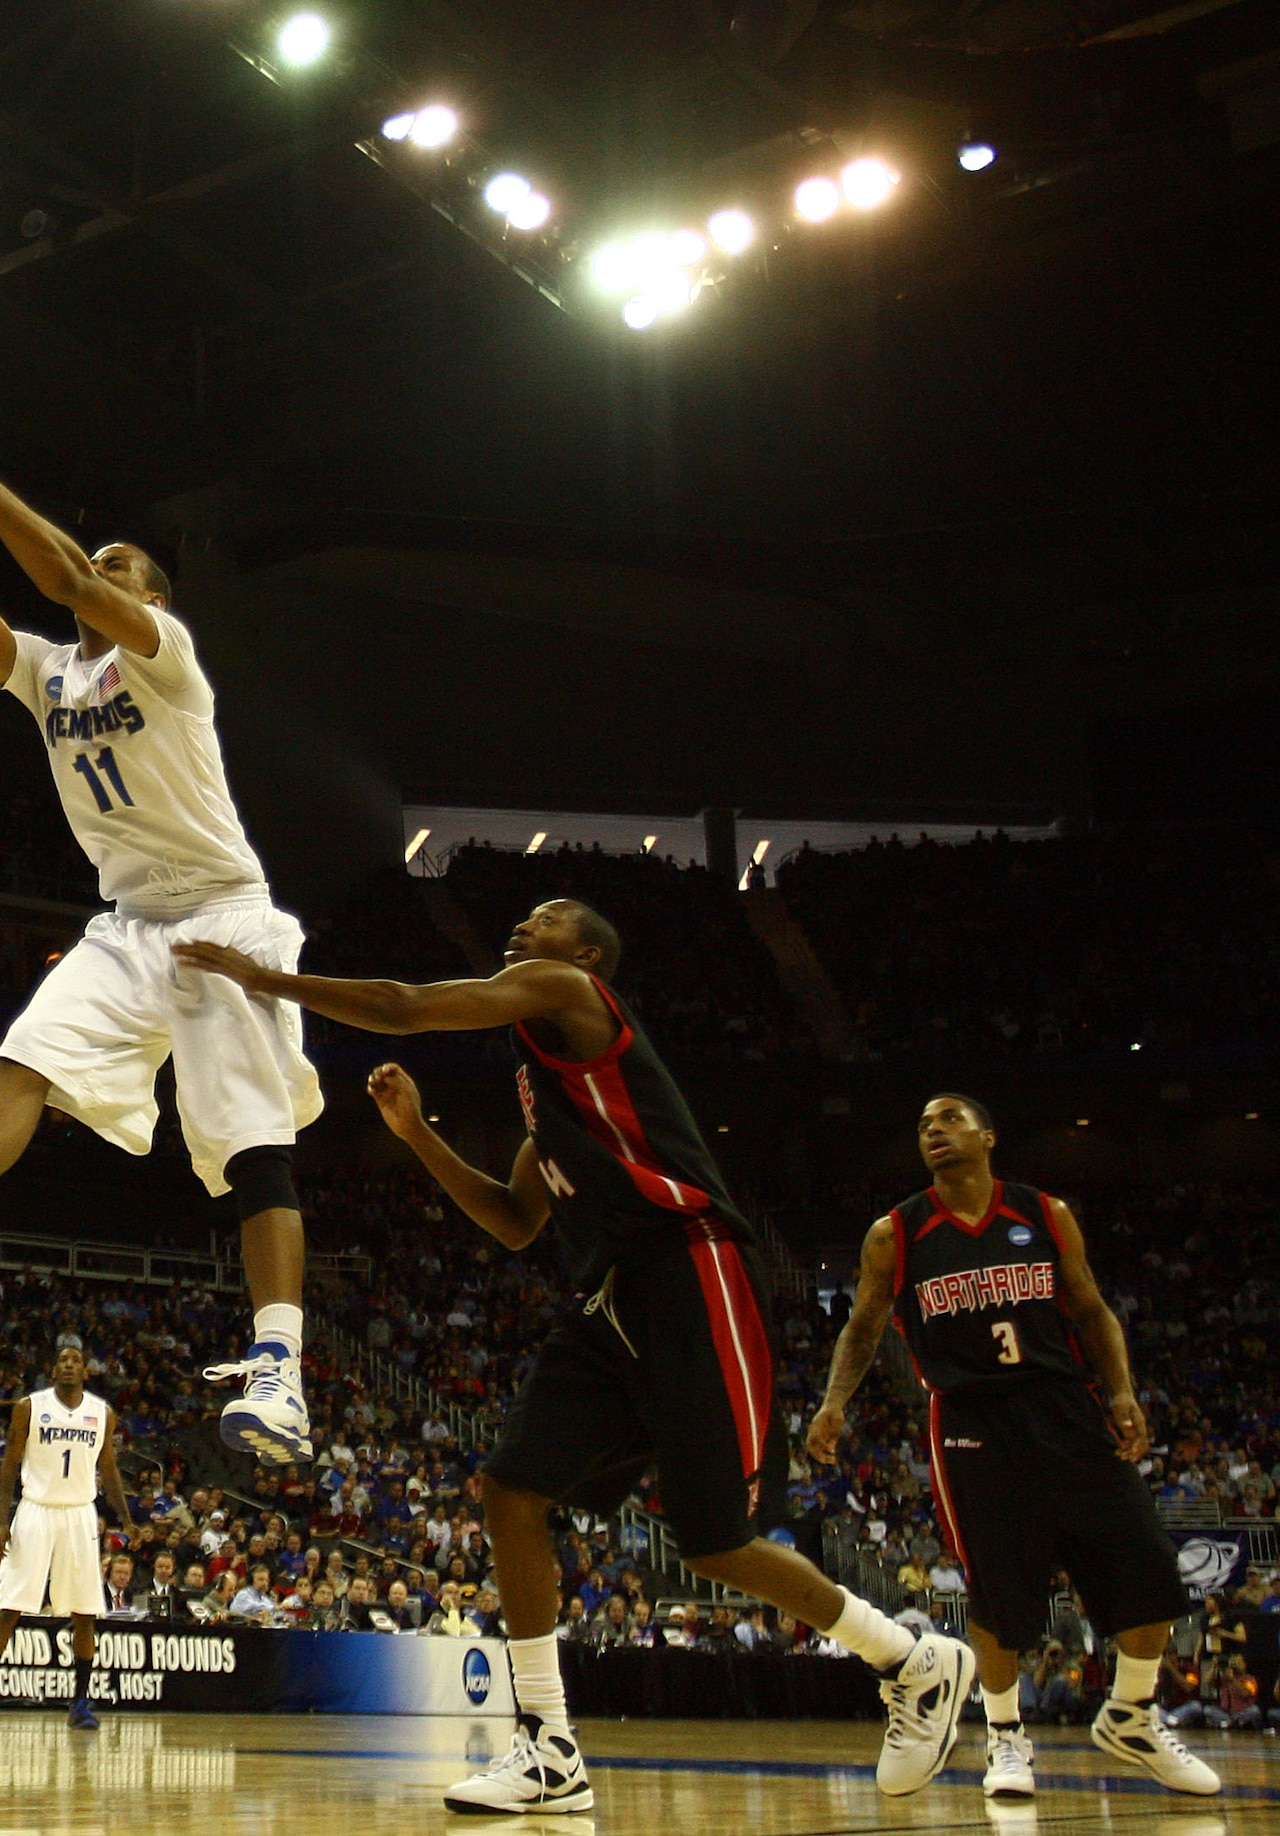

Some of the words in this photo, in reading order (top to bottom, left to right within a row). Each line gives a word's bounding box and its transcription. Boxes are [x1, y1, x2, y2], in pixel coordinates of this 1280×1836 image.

[72, 747, 135, 814] 11
[915, 1262, 1055, 1325] NORTHRIDGE
[990, 1320, 1022, 1365] 3
[39, 1427, 97, 1448] MEMPHIS
[61, 1449, 71, 1478] 1
[0, 1628, 53, 1666] AND
[150, 1634, 238, 1674] ROUNDS
[119, 1671, 166, 1701] HOST
